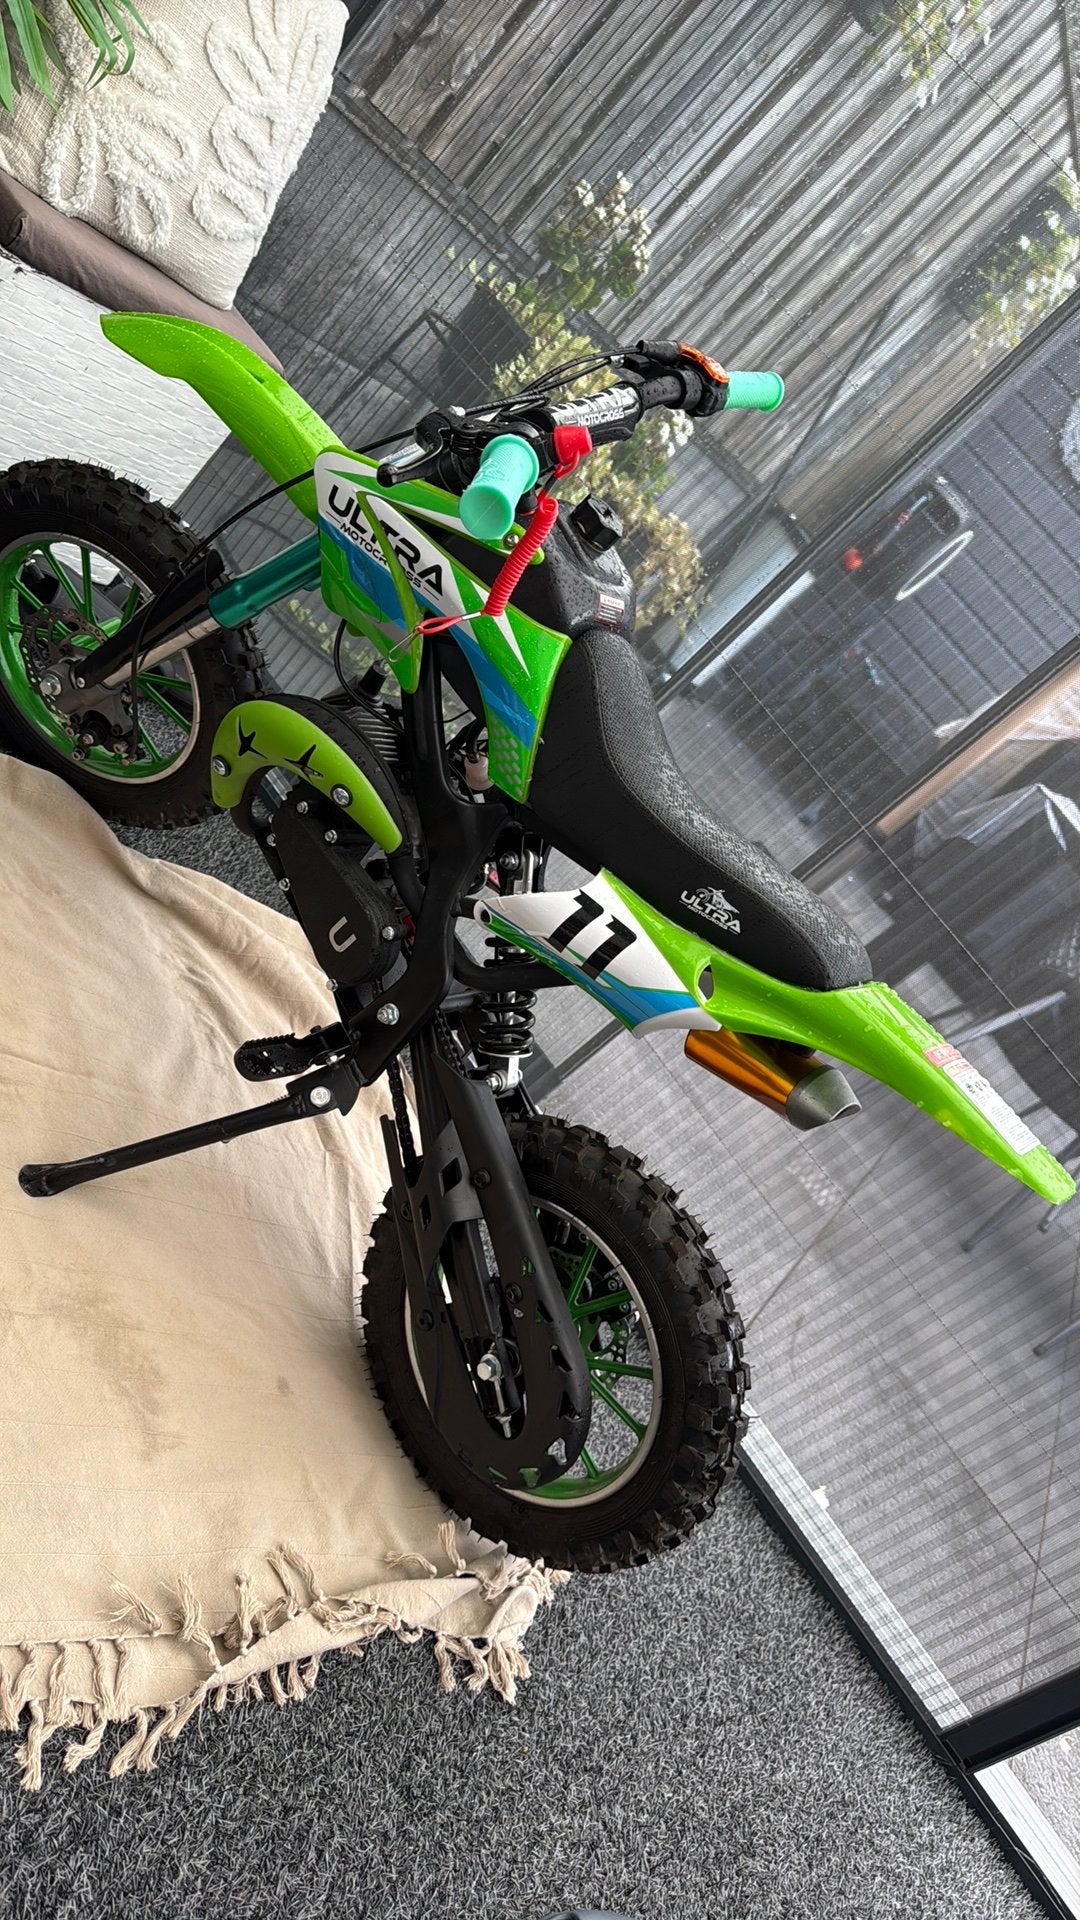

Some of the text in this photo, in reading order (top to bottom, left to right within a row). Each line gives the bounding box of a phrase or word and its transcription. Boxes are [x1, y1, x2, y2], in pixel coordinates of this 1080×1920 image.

[577, 408, 625, 427] MOTOCROSS
[328, 484, 443, 596] ULTRA
[680, 890, 740, 933] ULTRA
[687, 904, 728, 930] MOTOCROSS
[329, 915, 357, 952] U
[542, 888, 637, 981] 11
